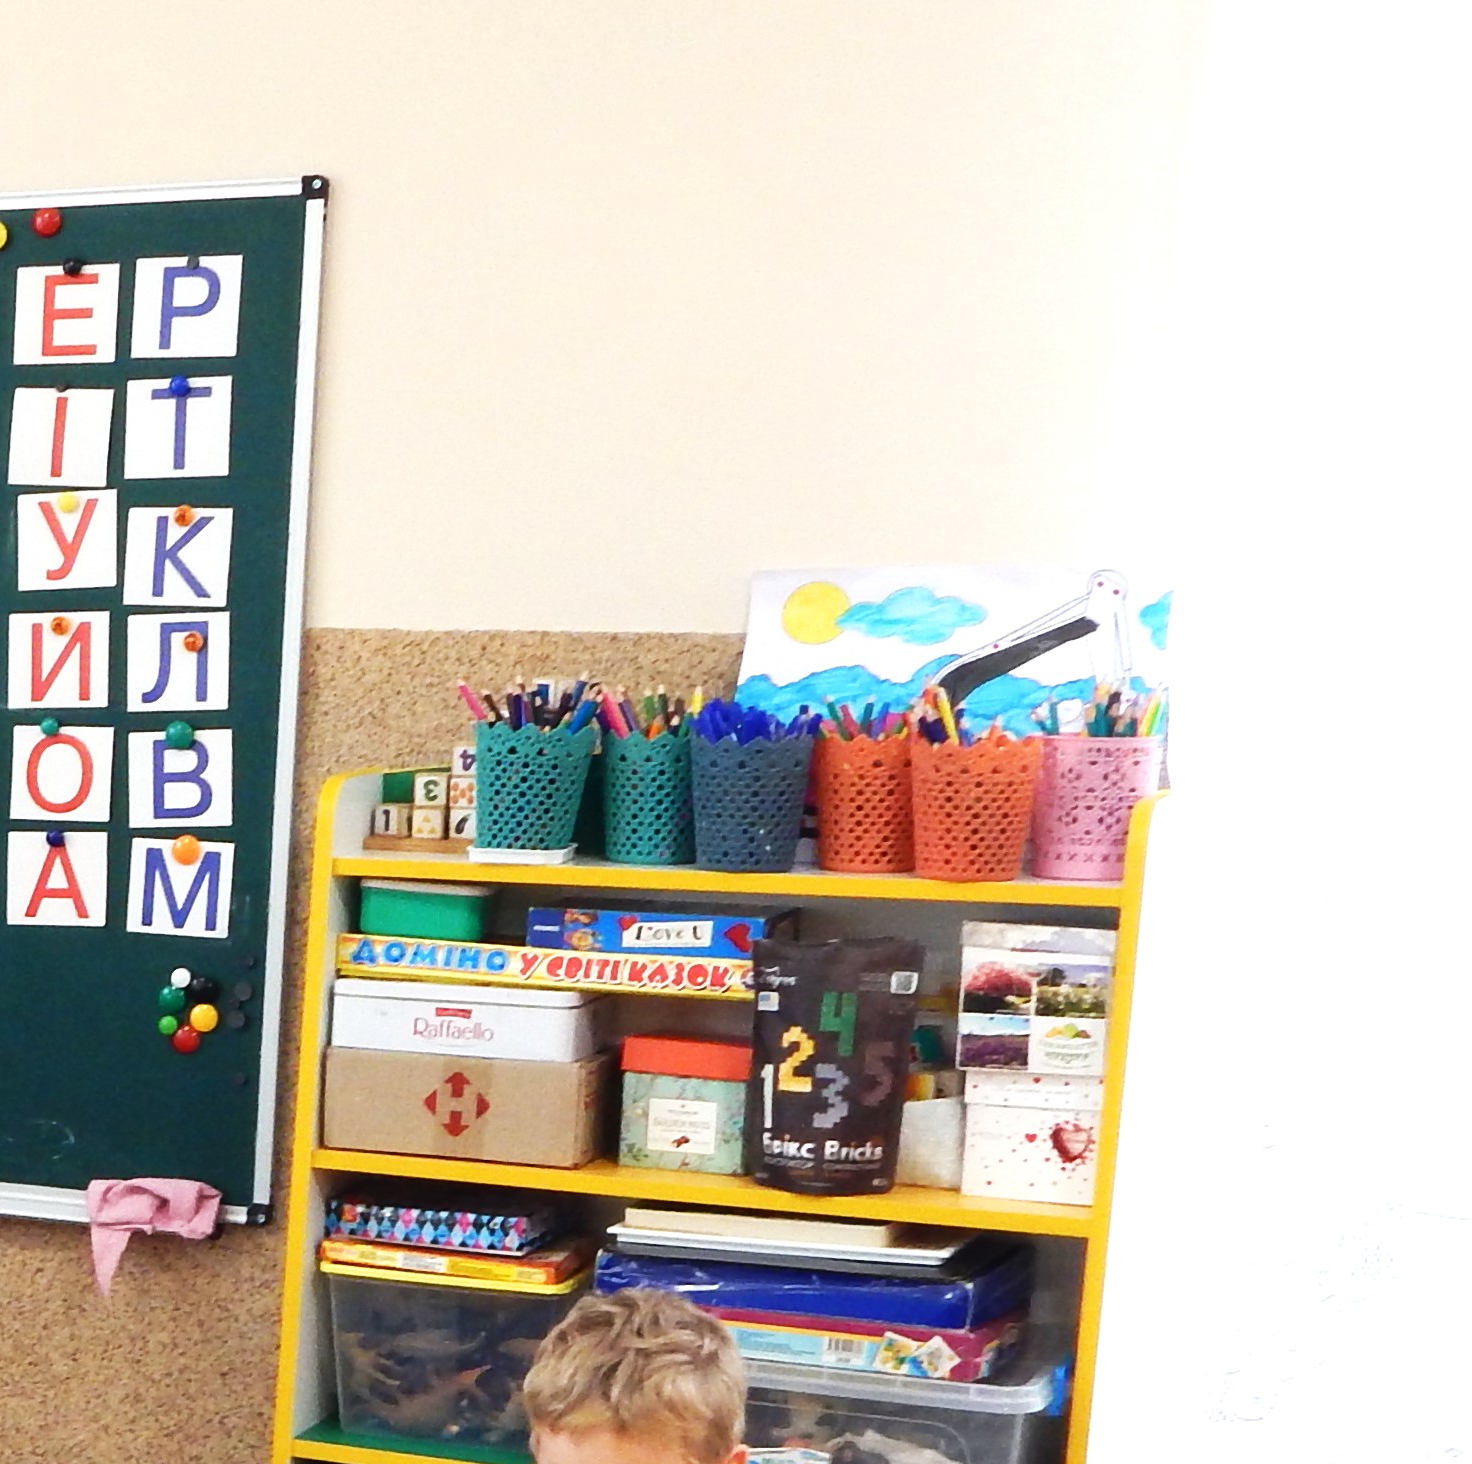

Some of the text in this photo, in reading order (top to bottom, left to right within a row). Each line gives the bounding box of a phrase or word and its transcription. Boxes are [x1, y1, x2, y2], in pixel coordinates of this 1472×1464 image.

[42, 266, 221, 357] Е Р
[50, 384, 213, 478] І Т
[38, 499, 215, 599] У К
[30, 622, 208, 704] И Л
[26, 733, 213, 820] О В
[24, 842, 220, 932] А М
[350, 938, 511, 975] ДОМІНО
[518, 951, 540, 979] У
[546, 954, 622, 983] СВІТІ
[626, 959, 732, 990] КАЗОК
[413, 1016, 495, 1042] Raffaello
[819, 990, 856, 1057] 4
[777, 1025, 816, 1093] 2
[857, 1041, 895, 1107] 5
[760, 1063, 775, 1129] 1
[812, 1062, 851, 1129] 3
